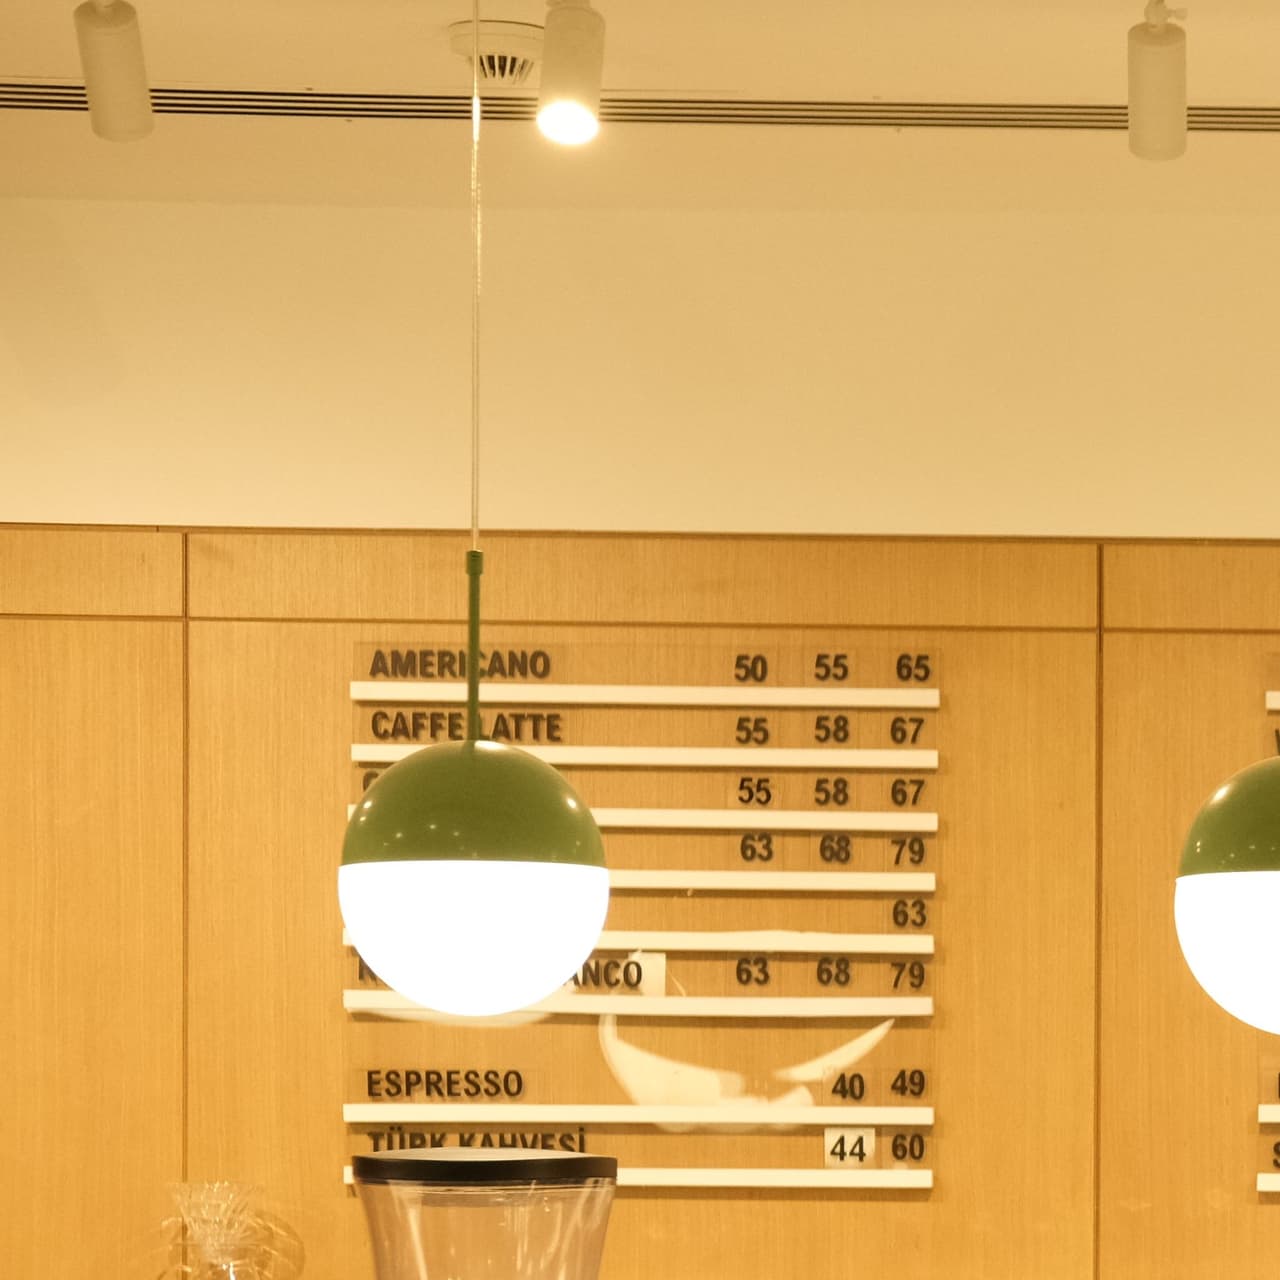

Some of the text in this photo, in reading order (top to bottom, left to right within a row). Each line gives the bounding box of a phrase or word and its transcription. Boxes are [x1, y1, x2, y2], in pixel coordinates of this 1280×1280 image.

[735, 654, 768, 680] 50
[814, 654, 848, 679] 55
[896, 655, 930, 681] 65
[371, 711, 924, 745] CAFFE LATTE 55 58 67
[738, 778, 924, 805] 55 58 67
[740, 834, 925, 864] 63 68 79
[892, 900, 927, 927] 63
[736, 958, 770, 985] 63
[817, 958, 851, 985] 68
[891, 961, 925, 988] 79
[367, 1070, 925, 1099] ESPRESSO 40 49
[830, 1135, 866, 1162] 44
[891, 1134, 925, 1161] 60
